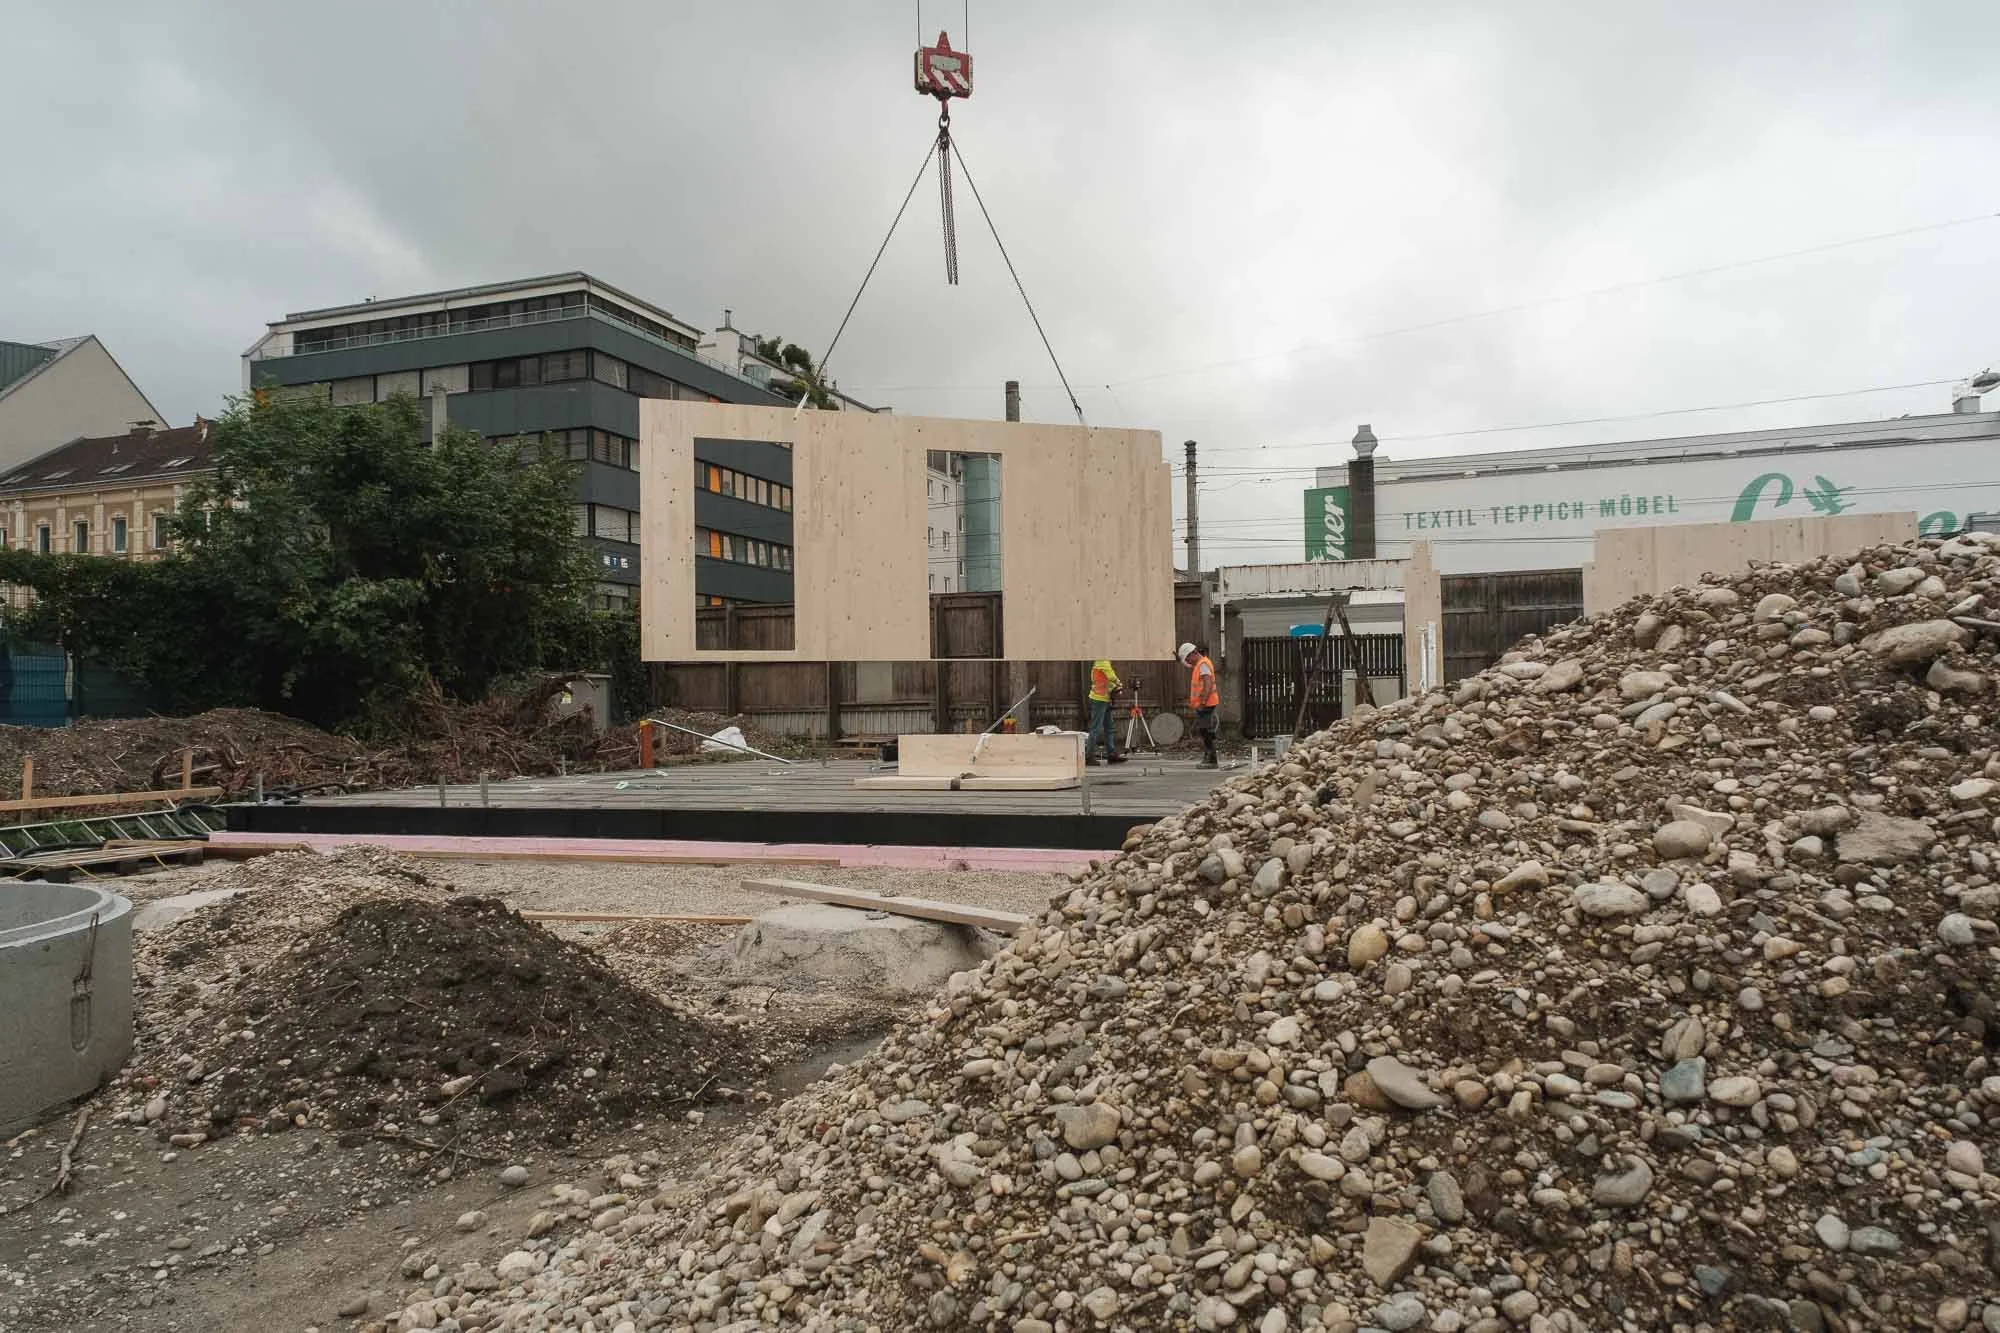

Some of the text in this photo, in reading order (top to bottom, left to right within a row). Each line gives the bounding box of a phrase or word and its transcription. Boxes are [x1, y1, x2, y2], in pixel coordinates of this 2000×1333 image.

[1403, 494, 1679, 530] TEXTIL TEPPICH MÖBEL
